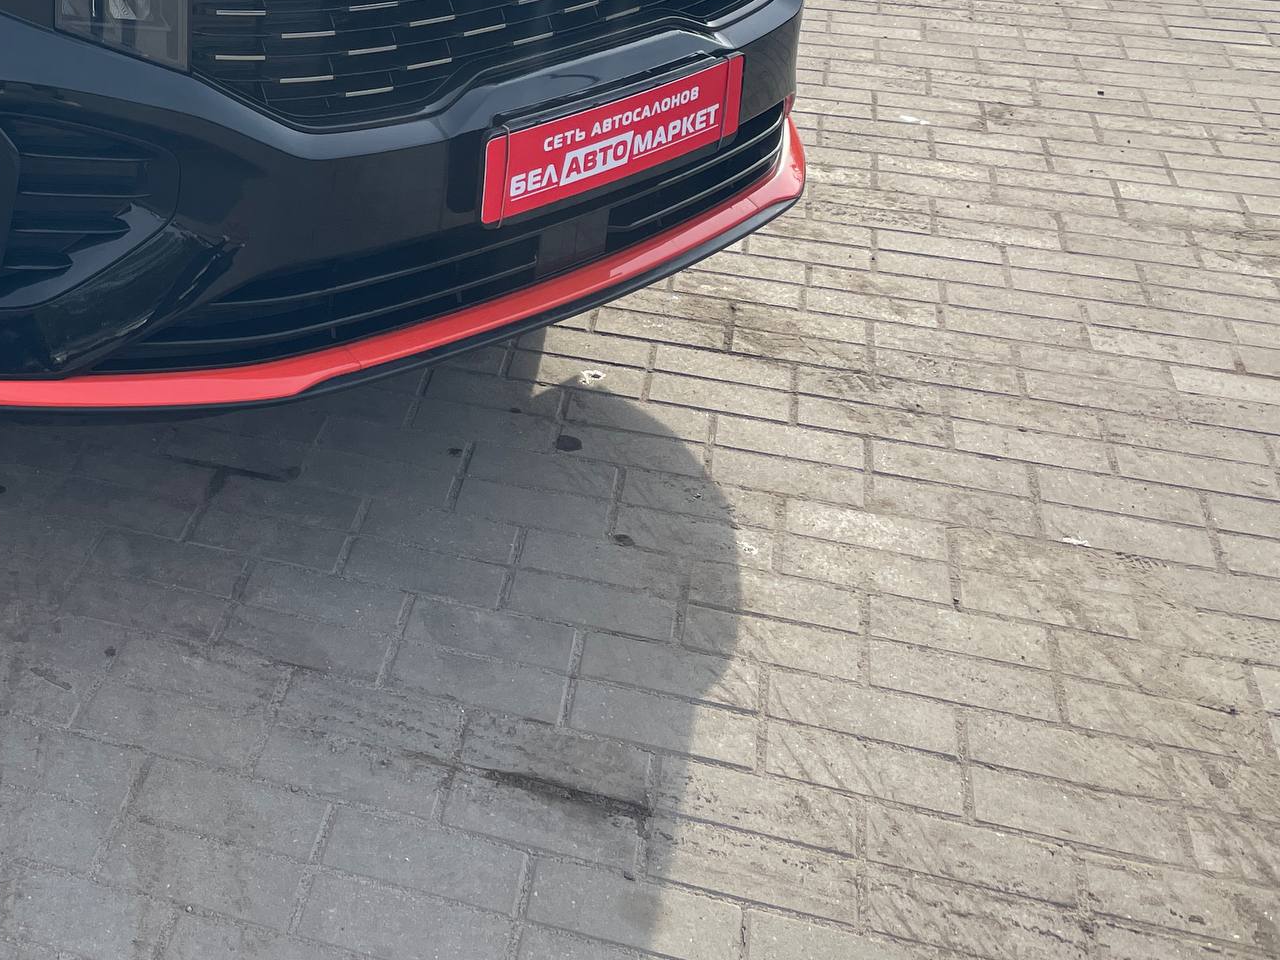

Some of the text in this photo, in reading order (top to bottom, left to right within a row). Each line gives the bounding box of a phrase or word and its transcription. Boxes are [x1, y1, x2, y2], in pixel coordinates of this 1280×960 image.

[510, 103, 720, 197] БЕЛАВТОМАРКЕТ
[543, 86, 699, 152] СЕТЬ АВТОСАЛОНОВ
